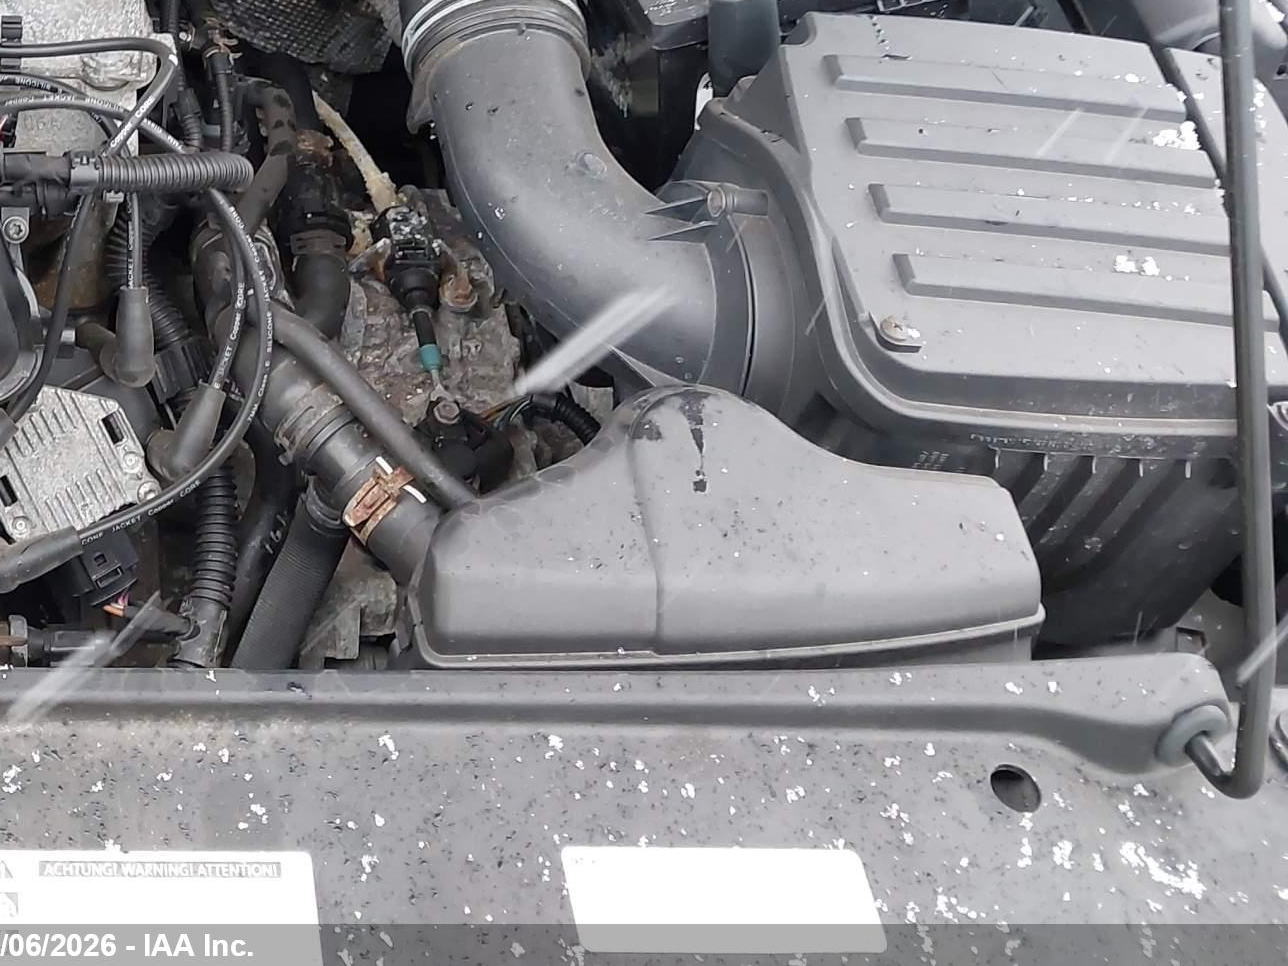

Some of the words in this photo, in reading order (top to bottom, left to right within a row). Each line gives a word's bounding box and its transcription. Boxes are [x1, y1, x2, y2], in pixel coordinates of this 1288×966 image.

[43, 93, 75, 103] JACKET
[135, 95, 156, 118] CORE
[230, 313, 241, 340] Copper
[236, 282, 245, 307] CORE
[45, 863, 120, 878] ACHTUNG!
[121, 863, 194, 878] WARNING!
[197, 863, 279, 878] ATTENTION!
